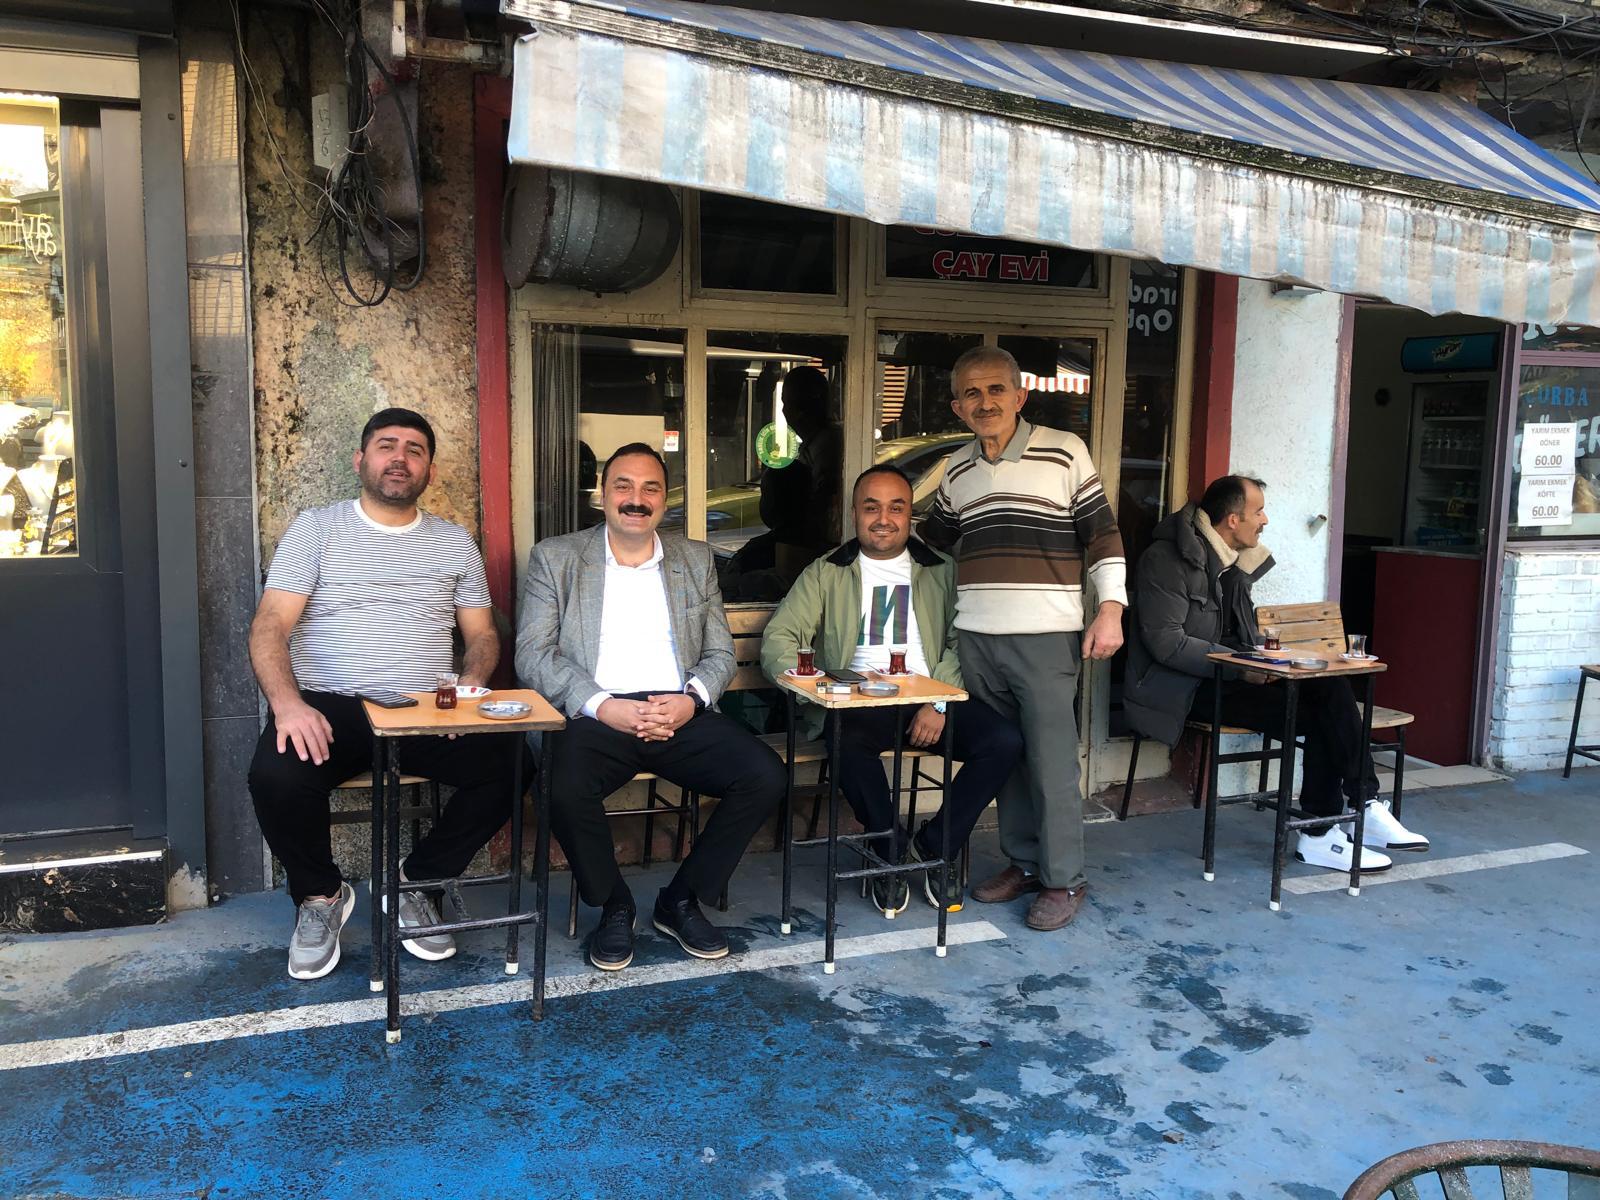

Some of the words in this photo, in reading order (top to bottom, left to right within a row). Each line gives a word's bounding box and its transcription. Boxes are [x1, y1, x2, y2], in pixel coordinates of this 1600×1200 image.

[933, 250, 994, 279] ÇAY
[1000, 250, 1049, 281] EVİ
[1535, 454, 1562, 466] 60.00
[1532, 505, 1559, 516] 60.00
